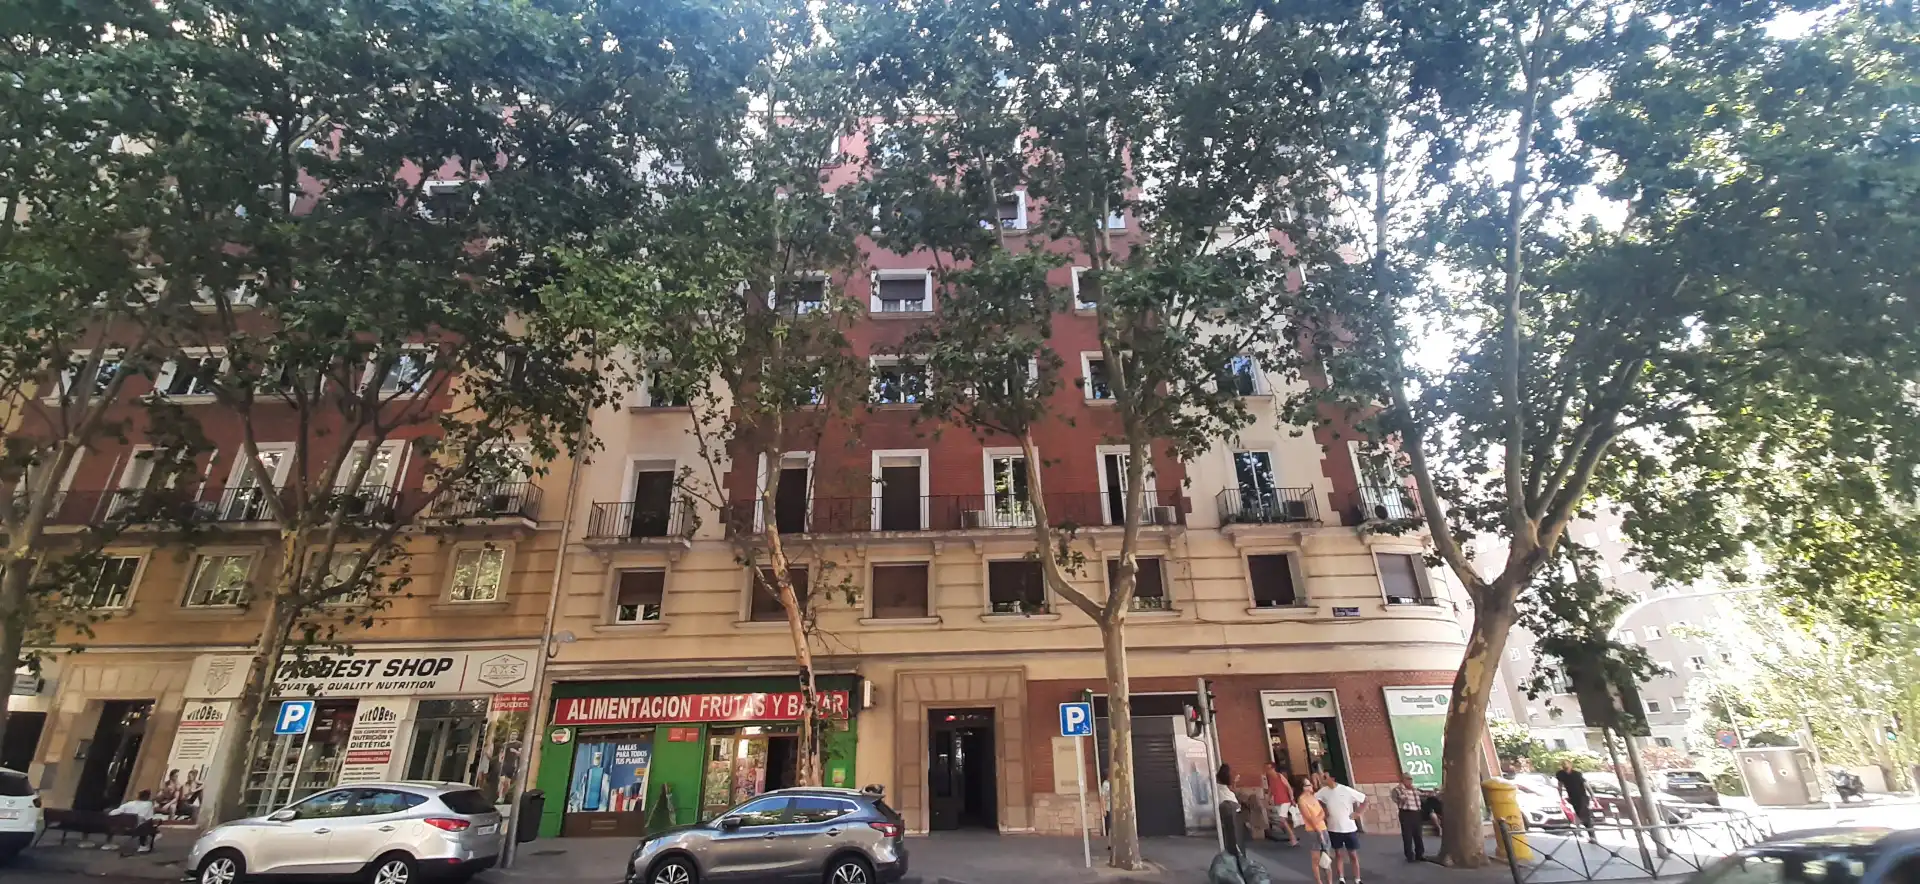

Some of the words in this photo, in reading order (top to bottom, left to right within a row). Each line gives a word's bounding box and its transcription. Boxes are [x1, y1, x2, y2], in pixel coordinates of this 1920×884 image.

[383, 657, 454, 677] SHOP
[327, 681, 374, 691] QUALITY
[375, 680, 436, 690] NUTRITION
[281, 704, 306, 730] P
[566, 696, 692, 721] ALIMENTACION
[699, 695, 766, 717] FRUTAS
[772, 695, 783, 716] Y
[1066, 706, 1085, 732] P
[350, 740, 391, 748] DIETÉTICA
[1403, 741, 1423, 756] 9h
[1424, 747, 1431, 756] a
[1406, 759, 1434, 775] 22h
